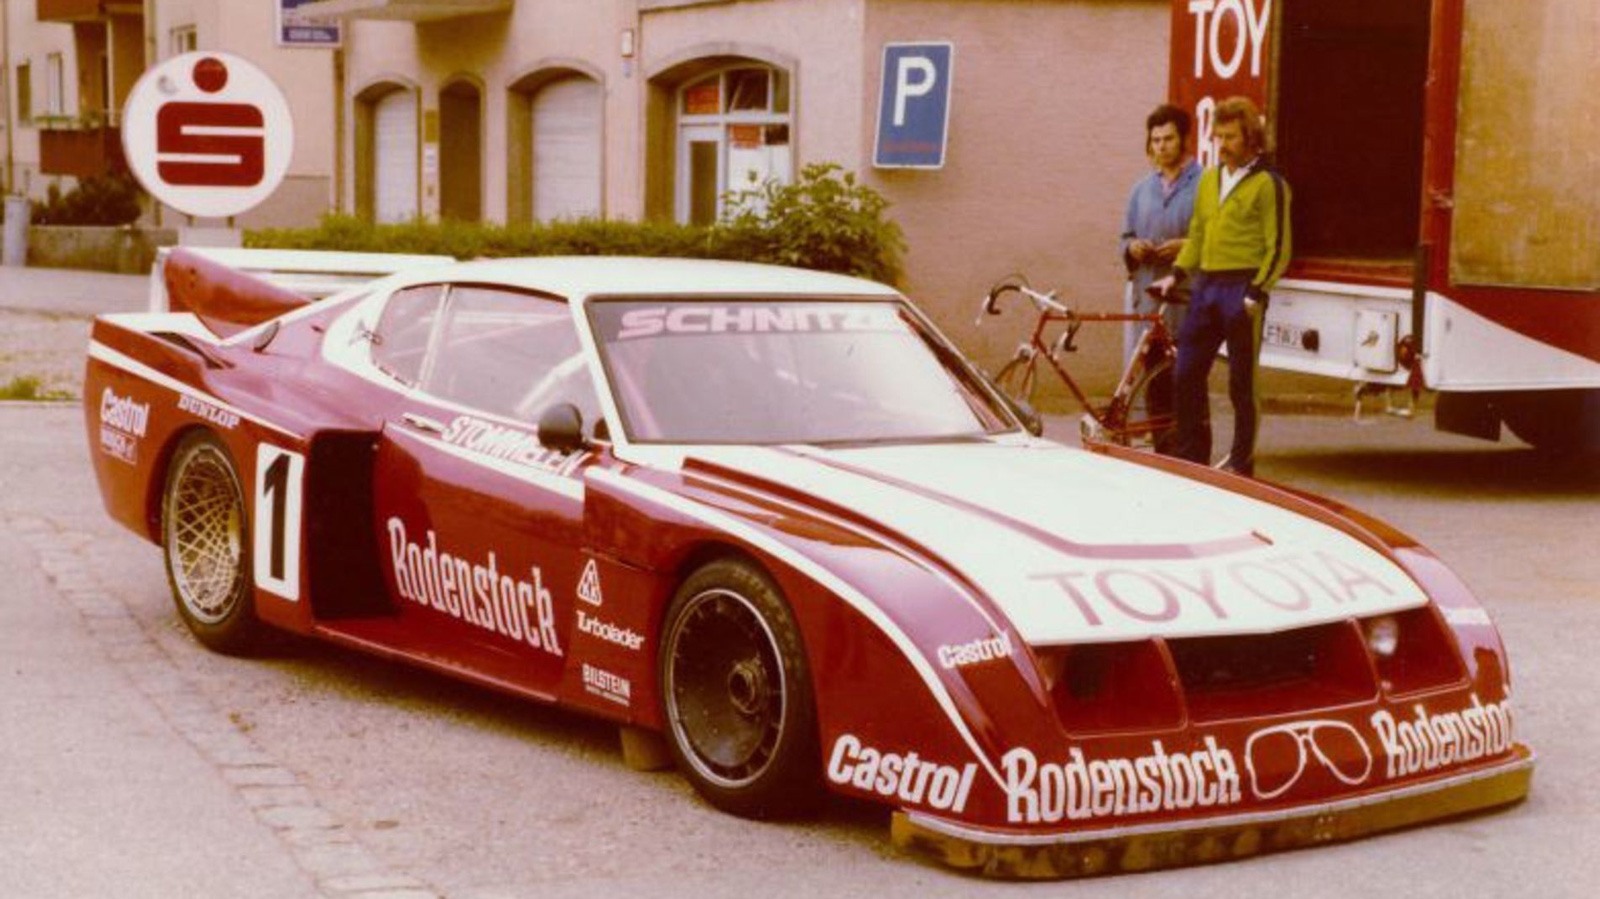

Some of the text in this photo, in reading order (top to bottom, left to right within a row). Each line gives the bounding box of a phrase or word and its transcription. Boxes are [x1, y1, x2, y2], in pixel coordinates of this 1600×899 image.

[1188, 0, 1271, 79] TOY
[893, 57, 936, 126] P
[101, 386, 149, 438] Castrol
[177, 393, 241, 430] DUNLOP
[264, 453, 291, 582] 1
[388, 516, 564, 658] Rodenstock
[1027, 552, 1396, 626] TOYOTA
[576, 609, 645, 651] Turbolader
[937, 631, 1013, 670] Castrol
[582, 662, 631, 698] BILSTEIN
[827, 733, 979, 813] Castrol
[1001, 735, 1242, 823] Rodenstock
